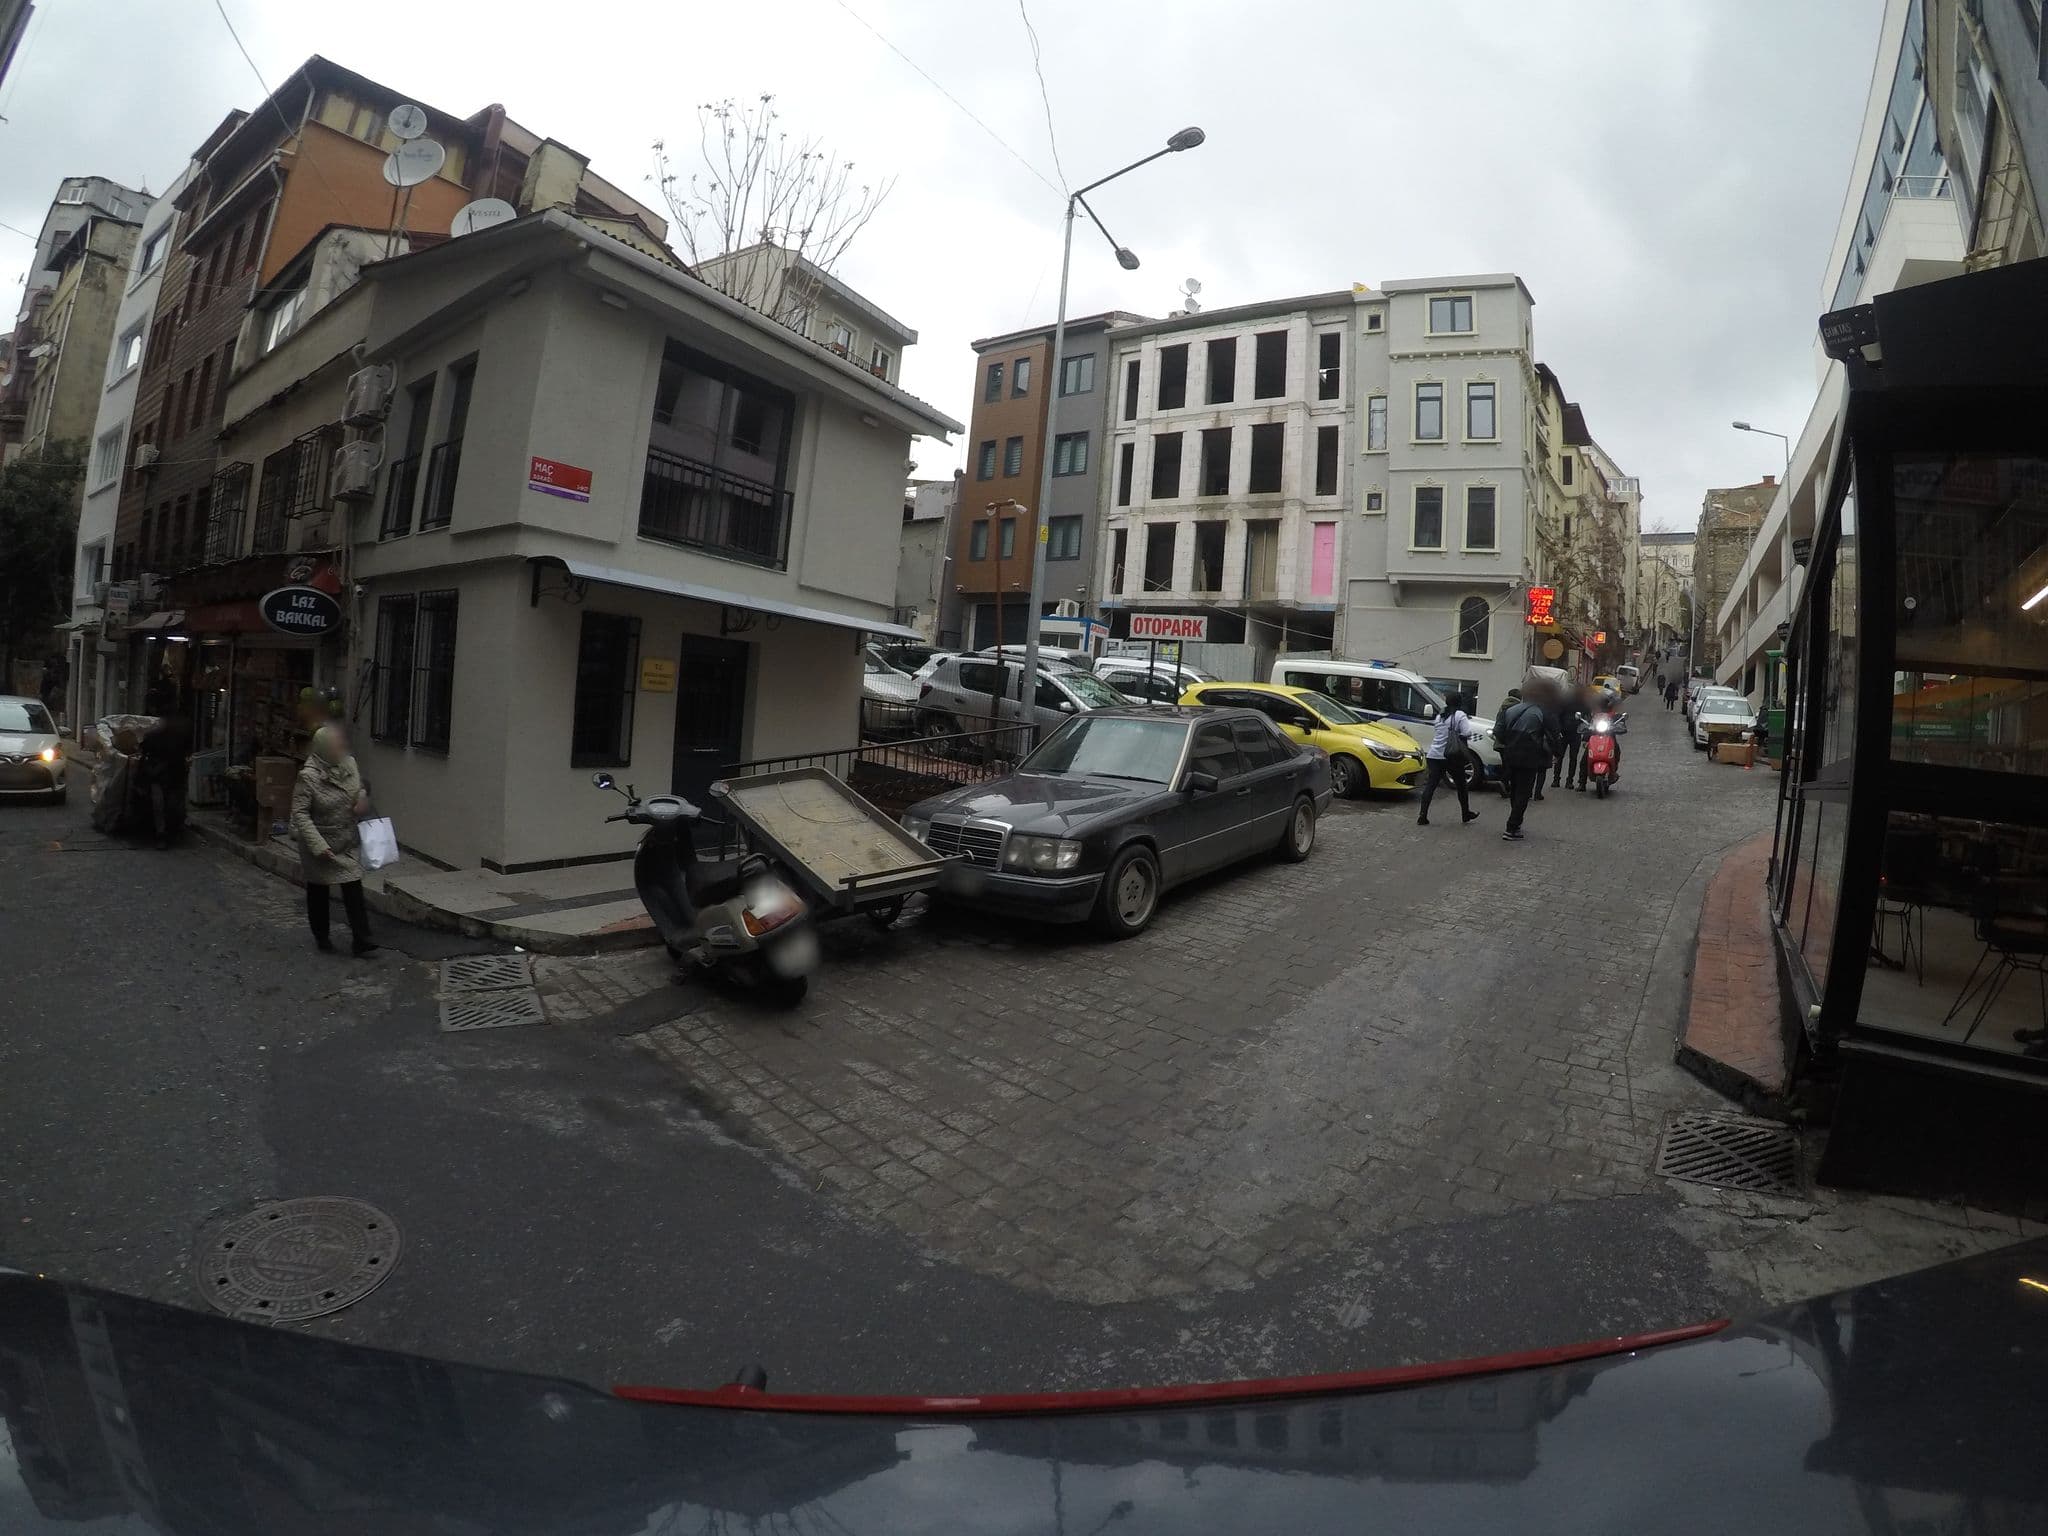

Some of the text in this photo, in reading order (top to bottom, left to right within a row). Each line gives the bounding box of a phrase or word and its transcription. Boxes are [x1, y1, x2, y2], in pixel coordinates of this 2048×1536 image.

[292, 595, 316, 609] LAZ
[276, 610, 327, 627] BAKKAL
[1133, 616, 1203, 638] OTOPARK
